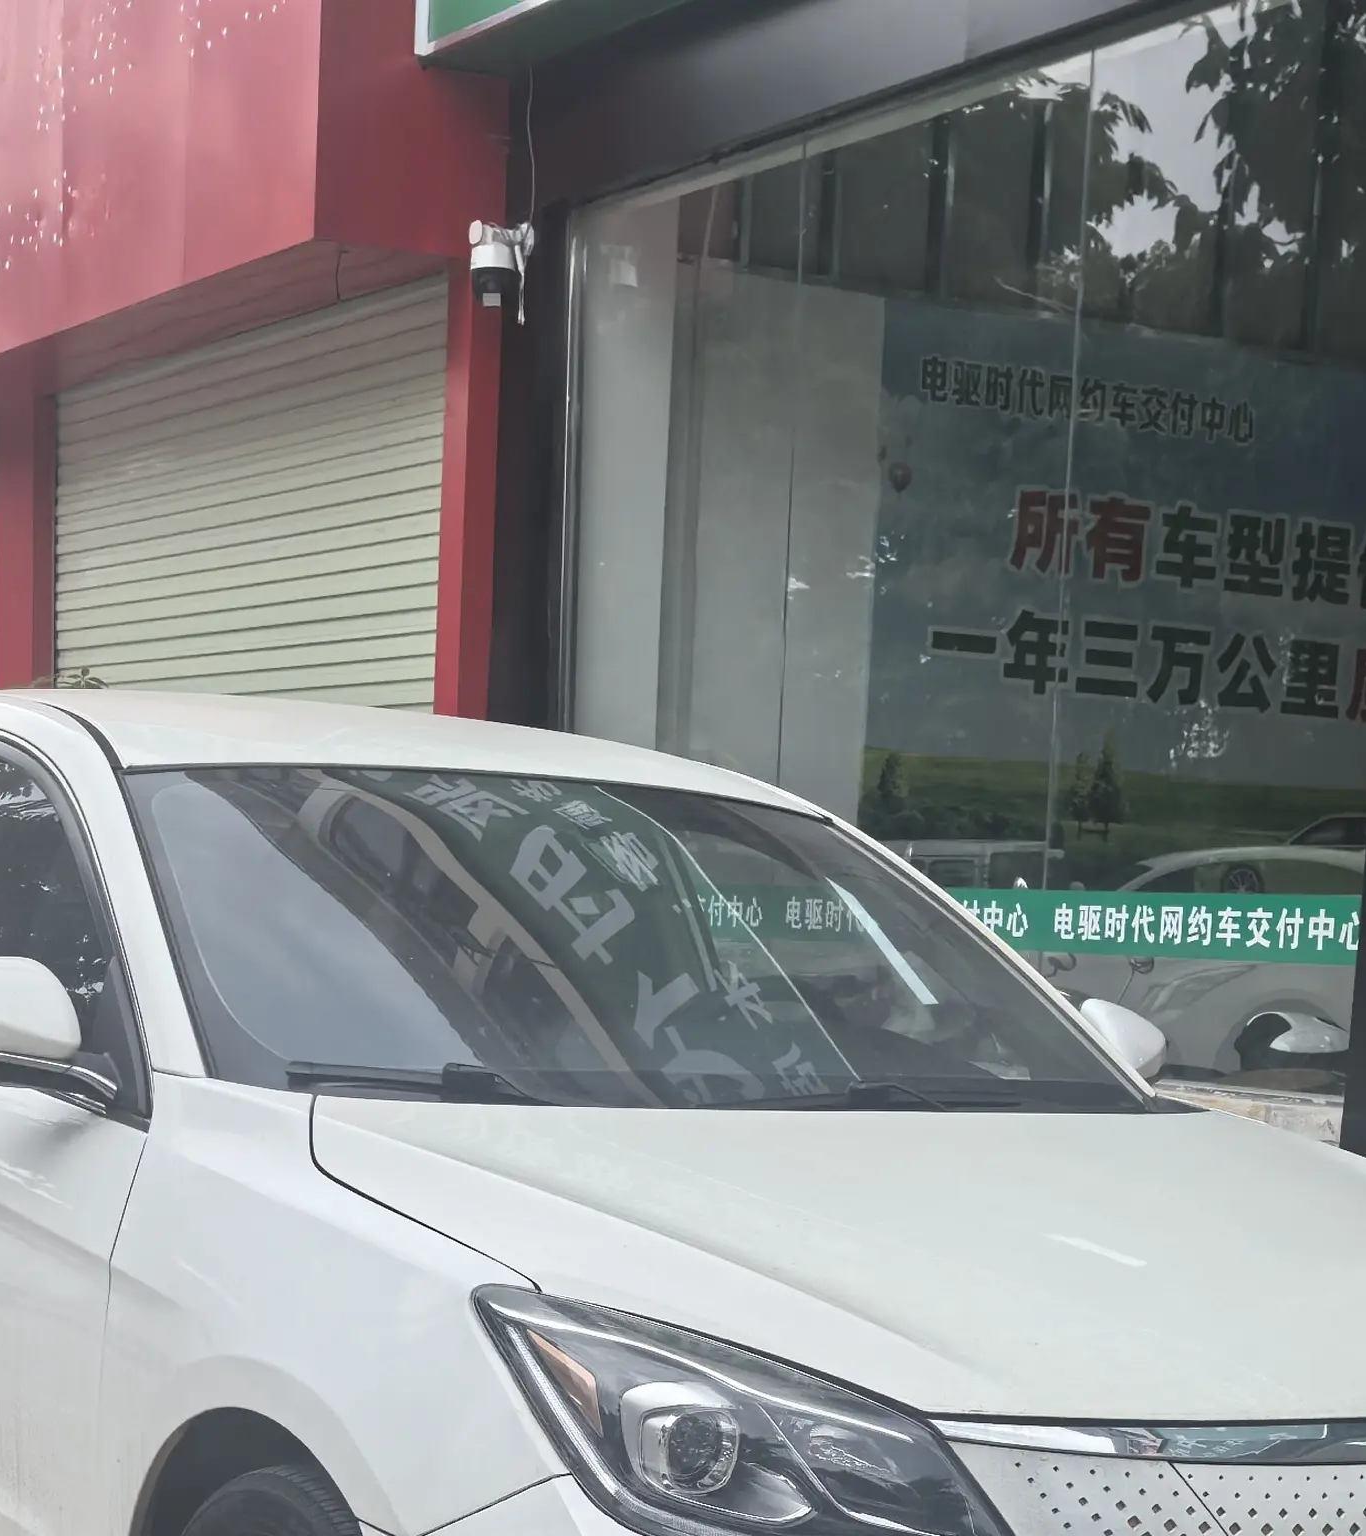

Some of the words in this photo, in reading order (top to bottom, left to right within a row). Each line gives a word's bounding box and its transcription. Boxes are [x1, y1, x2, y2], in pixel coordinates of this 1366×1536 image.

[921, 357, 1254, 442] 电驱时代网约车交付中心
[1053, 903, 1360, 951] 电驱时代网约车交付中心
